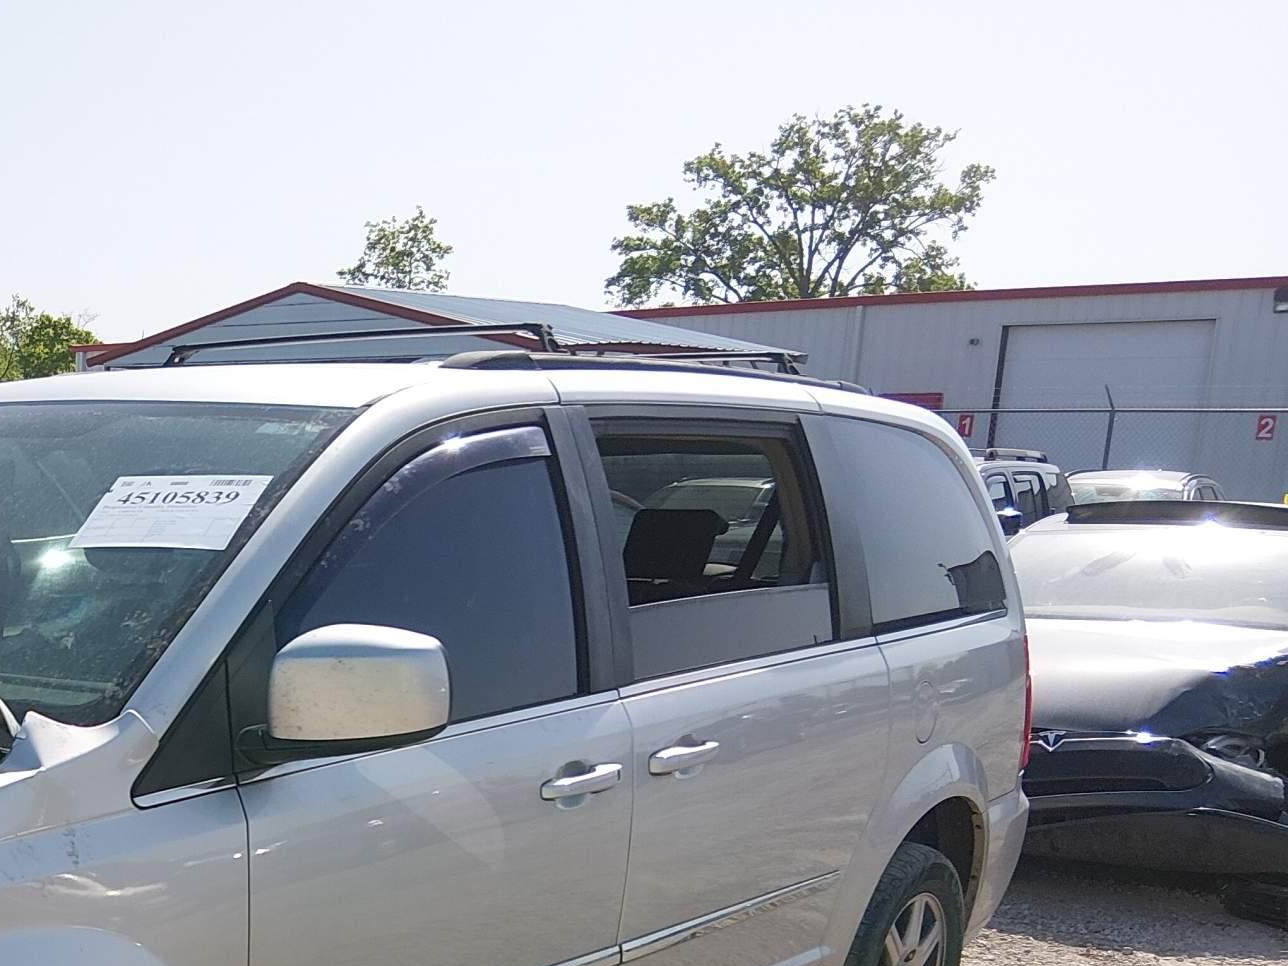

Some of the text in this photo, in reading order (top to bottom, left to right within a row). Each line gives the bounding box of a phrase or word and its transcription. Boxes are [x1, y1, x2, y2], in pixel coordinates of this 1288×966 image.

[962, 417, 971, 434] 1
[1258, 417, 1274, 438] 2
[116, 490, 240, 505] 45105839
